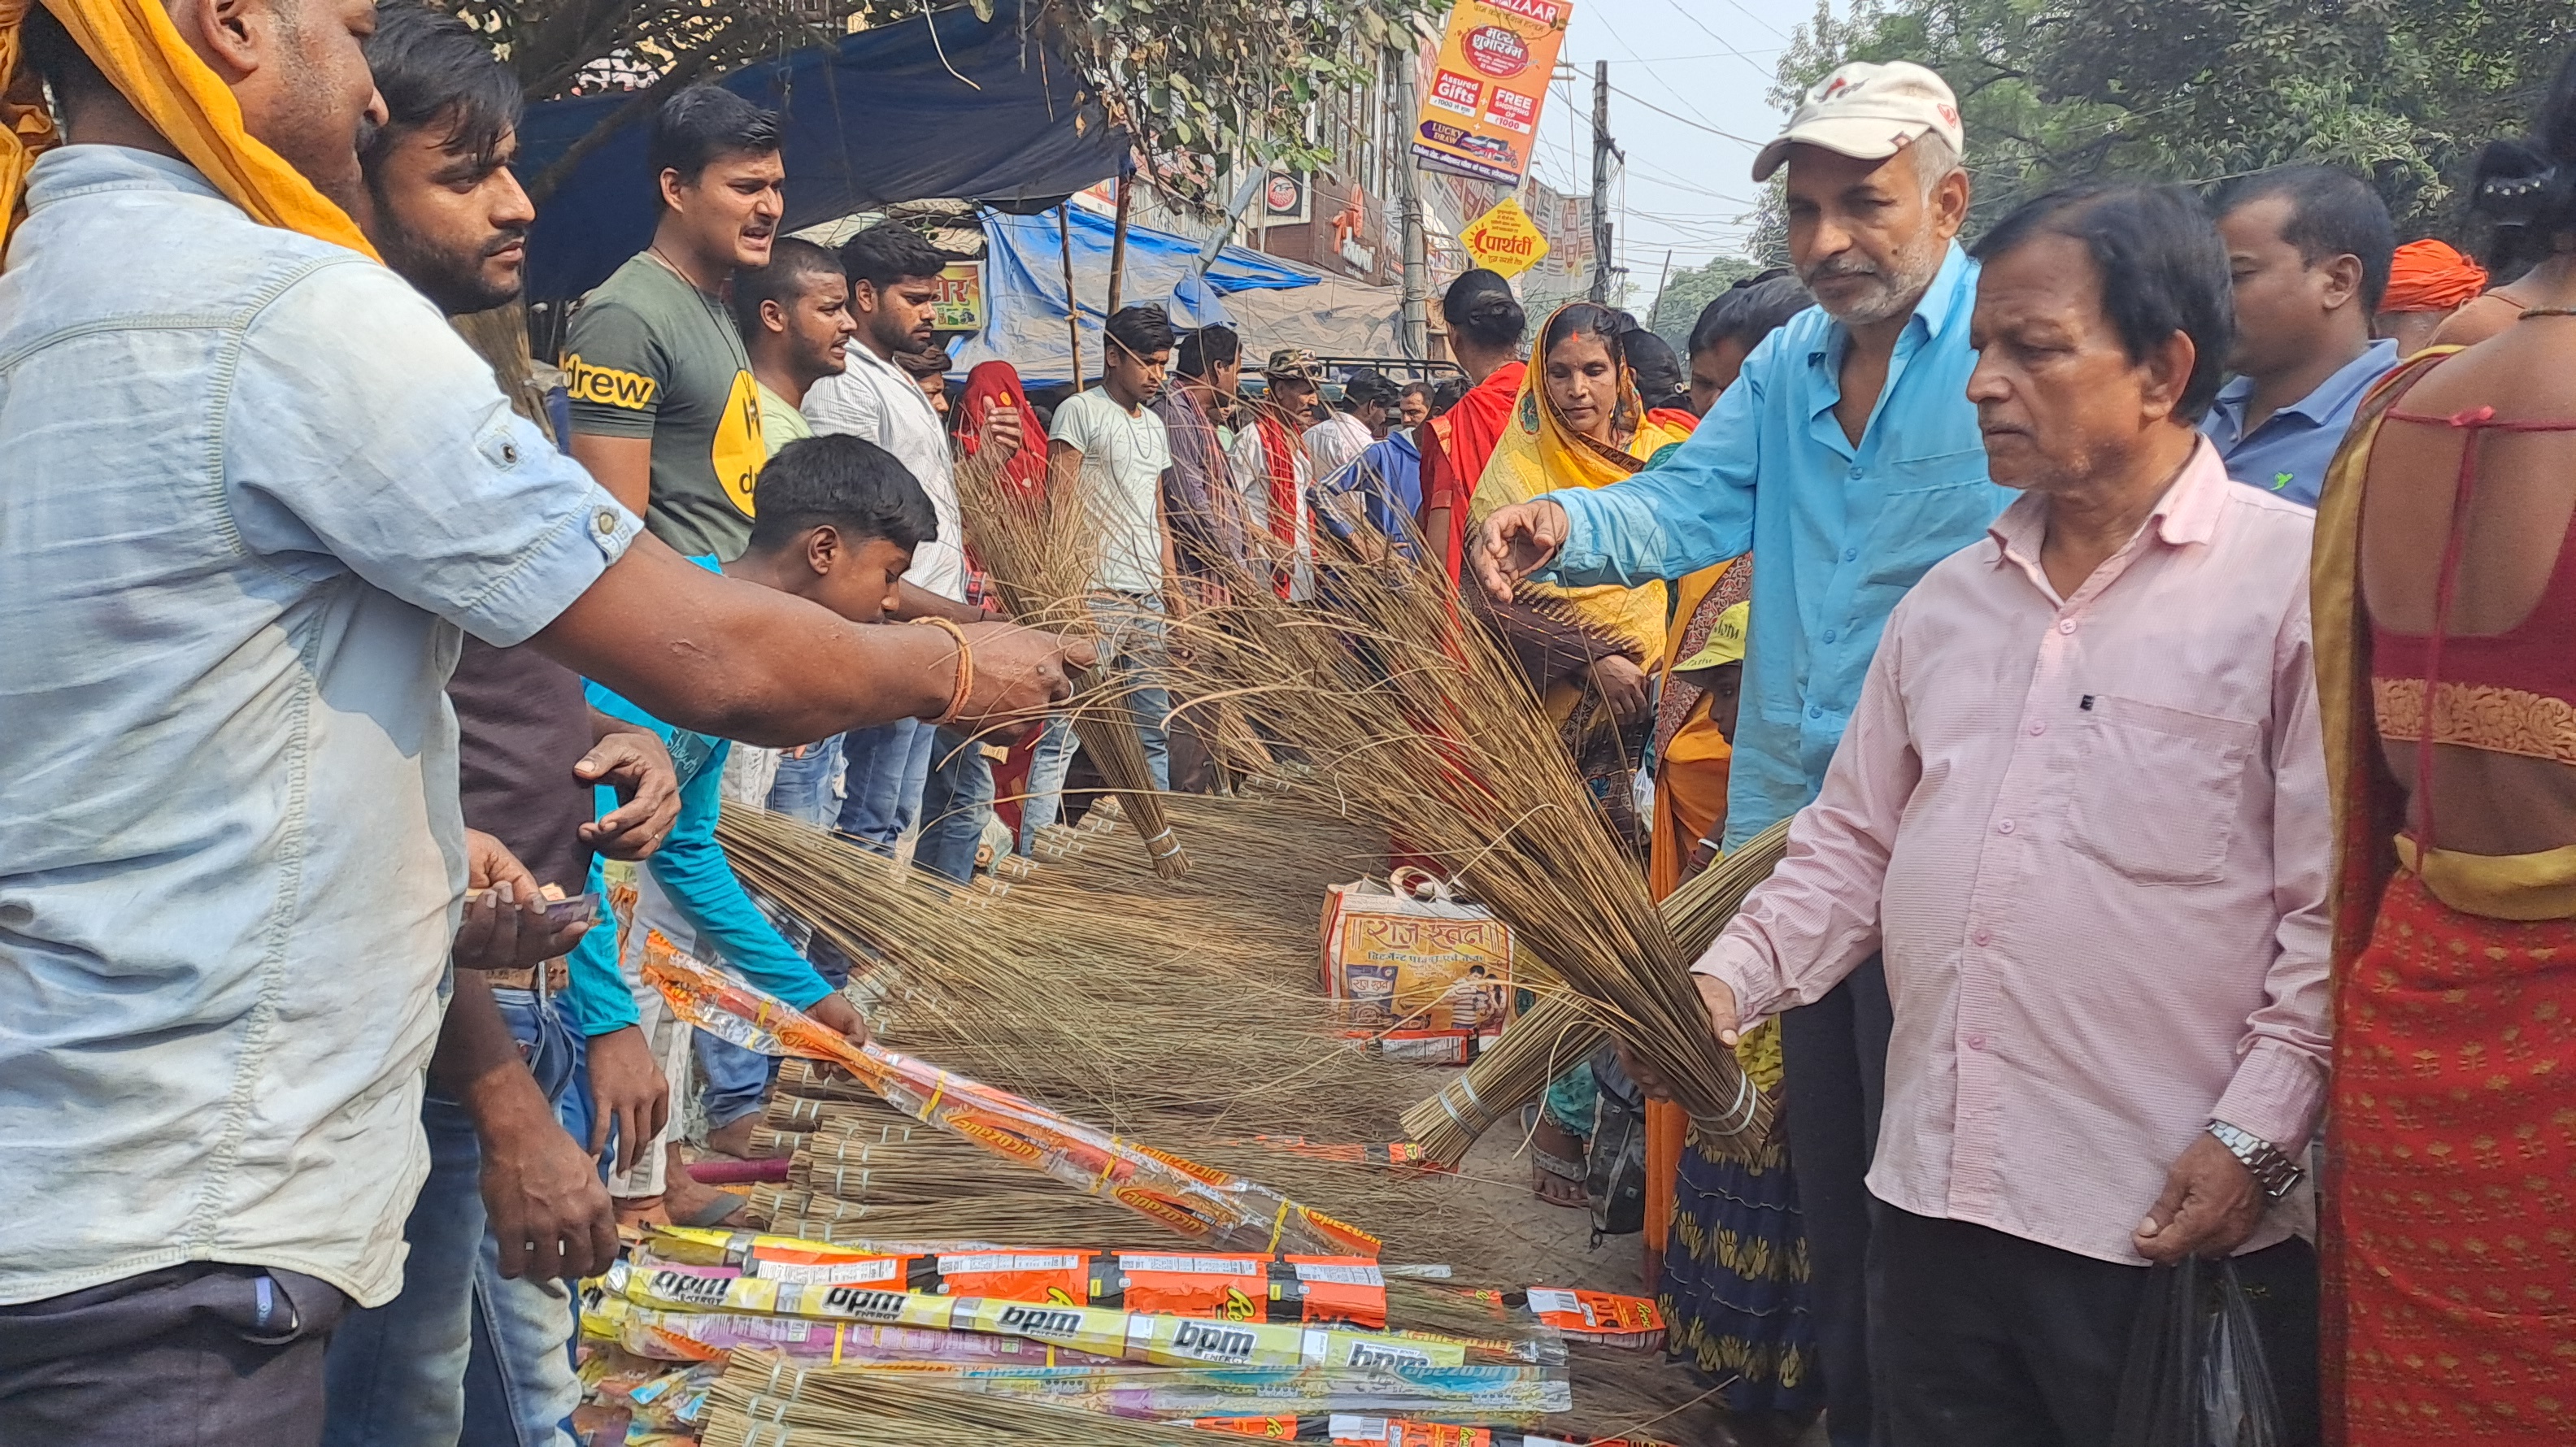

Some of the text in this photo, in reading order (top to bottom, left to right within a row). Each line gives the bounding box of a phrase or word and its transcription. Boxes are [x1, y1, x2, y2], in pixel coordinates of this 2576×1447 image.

[1489, 0, 1556, 22] AZAAR
[1440, 72, 1479, 90] Assured
[1436, 81, 1476, 104] Gifts
[1495, 89, 1533, 109] FREE
[1431, 122, 1464, 139] LUCKY
[1433, 132, 1457, 145] DRAW
[1486, 235, 1531, 256] पार्थवी
[1367, 919, 1419, 949] राज
[1125, 1189, 1208, 1236] Lucozade
[825, 1287, 907, 1313] bpm
[999, 1306, 1082, 1332] bpm
[1173, 1321, 1255, 1356] bpm
[1203, 1353, 1250, 1365] ENERGY
